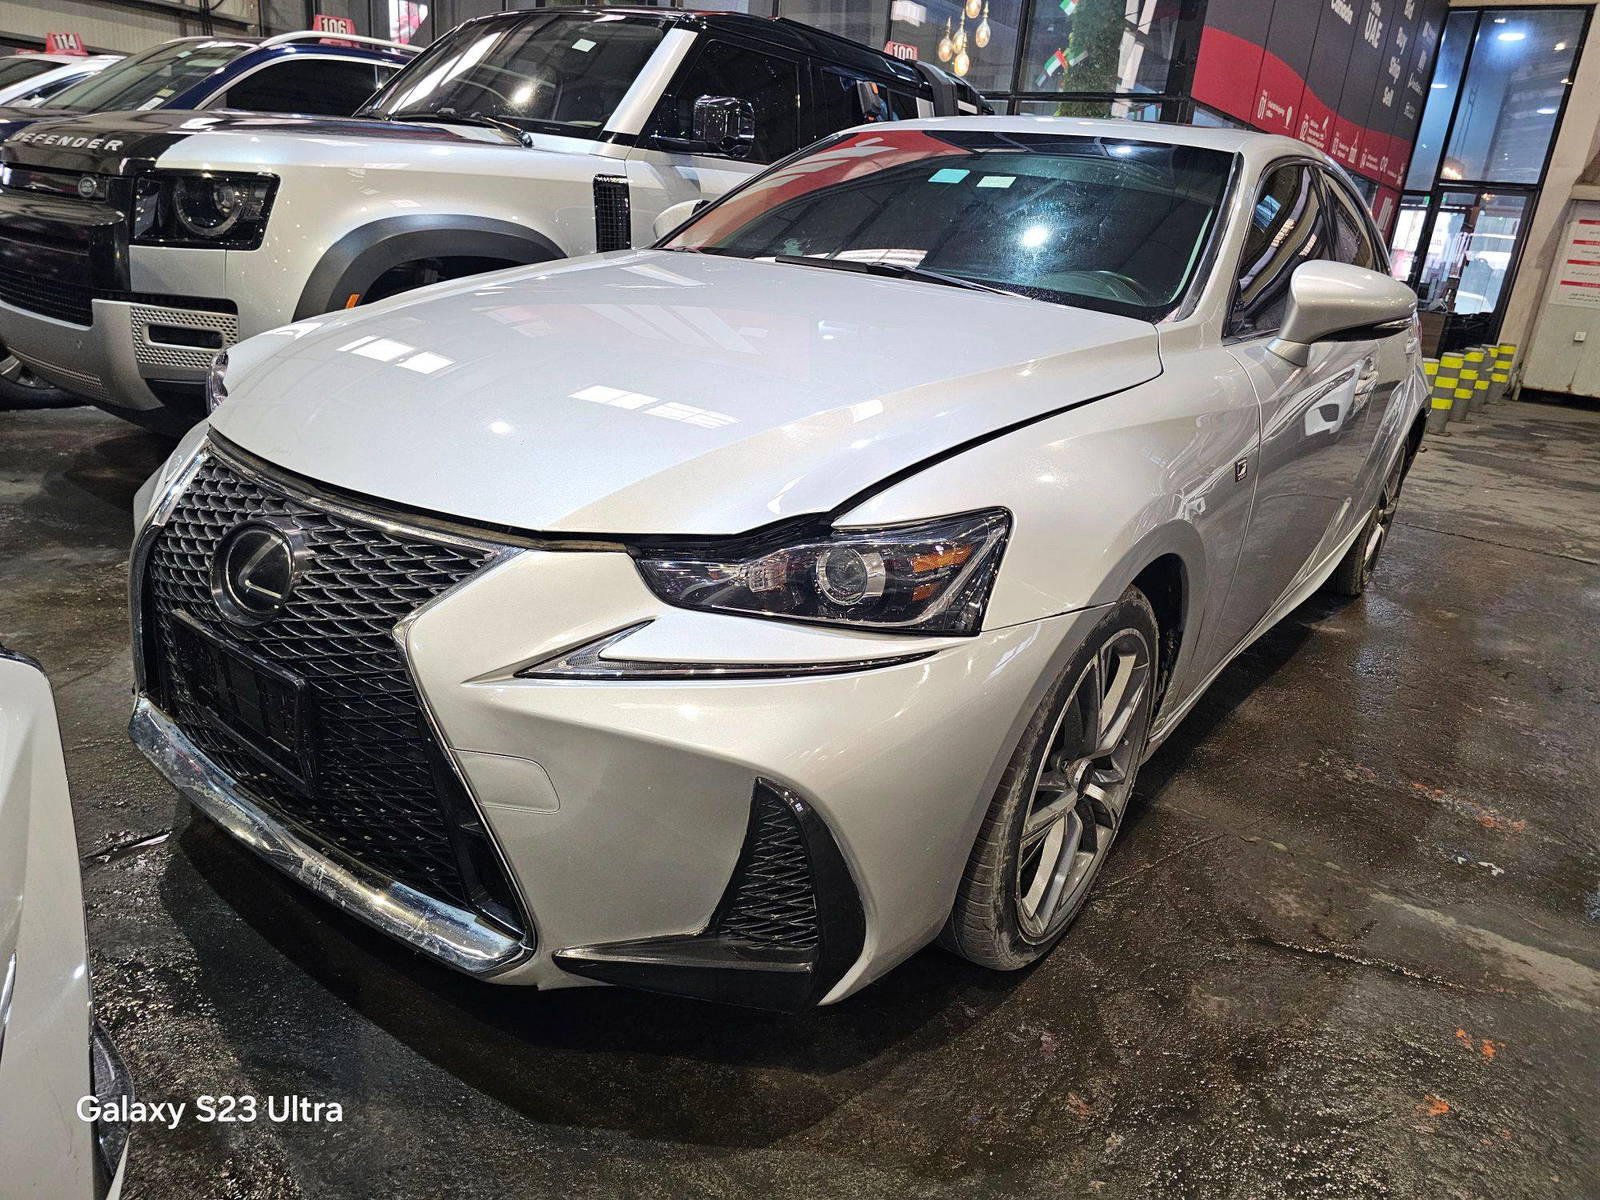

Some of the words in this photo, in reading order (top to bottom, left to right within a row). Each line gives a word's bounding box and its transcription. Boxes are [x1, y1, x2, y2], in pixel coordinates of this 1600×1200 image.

[322, 17, 347, 34] 106
[1364, 11, 1383, 49] UAE
[55, 33, 78, 49] 114
[893, 44, 913, 60] 100
[11, 132, 123, 151] DEFENDER
